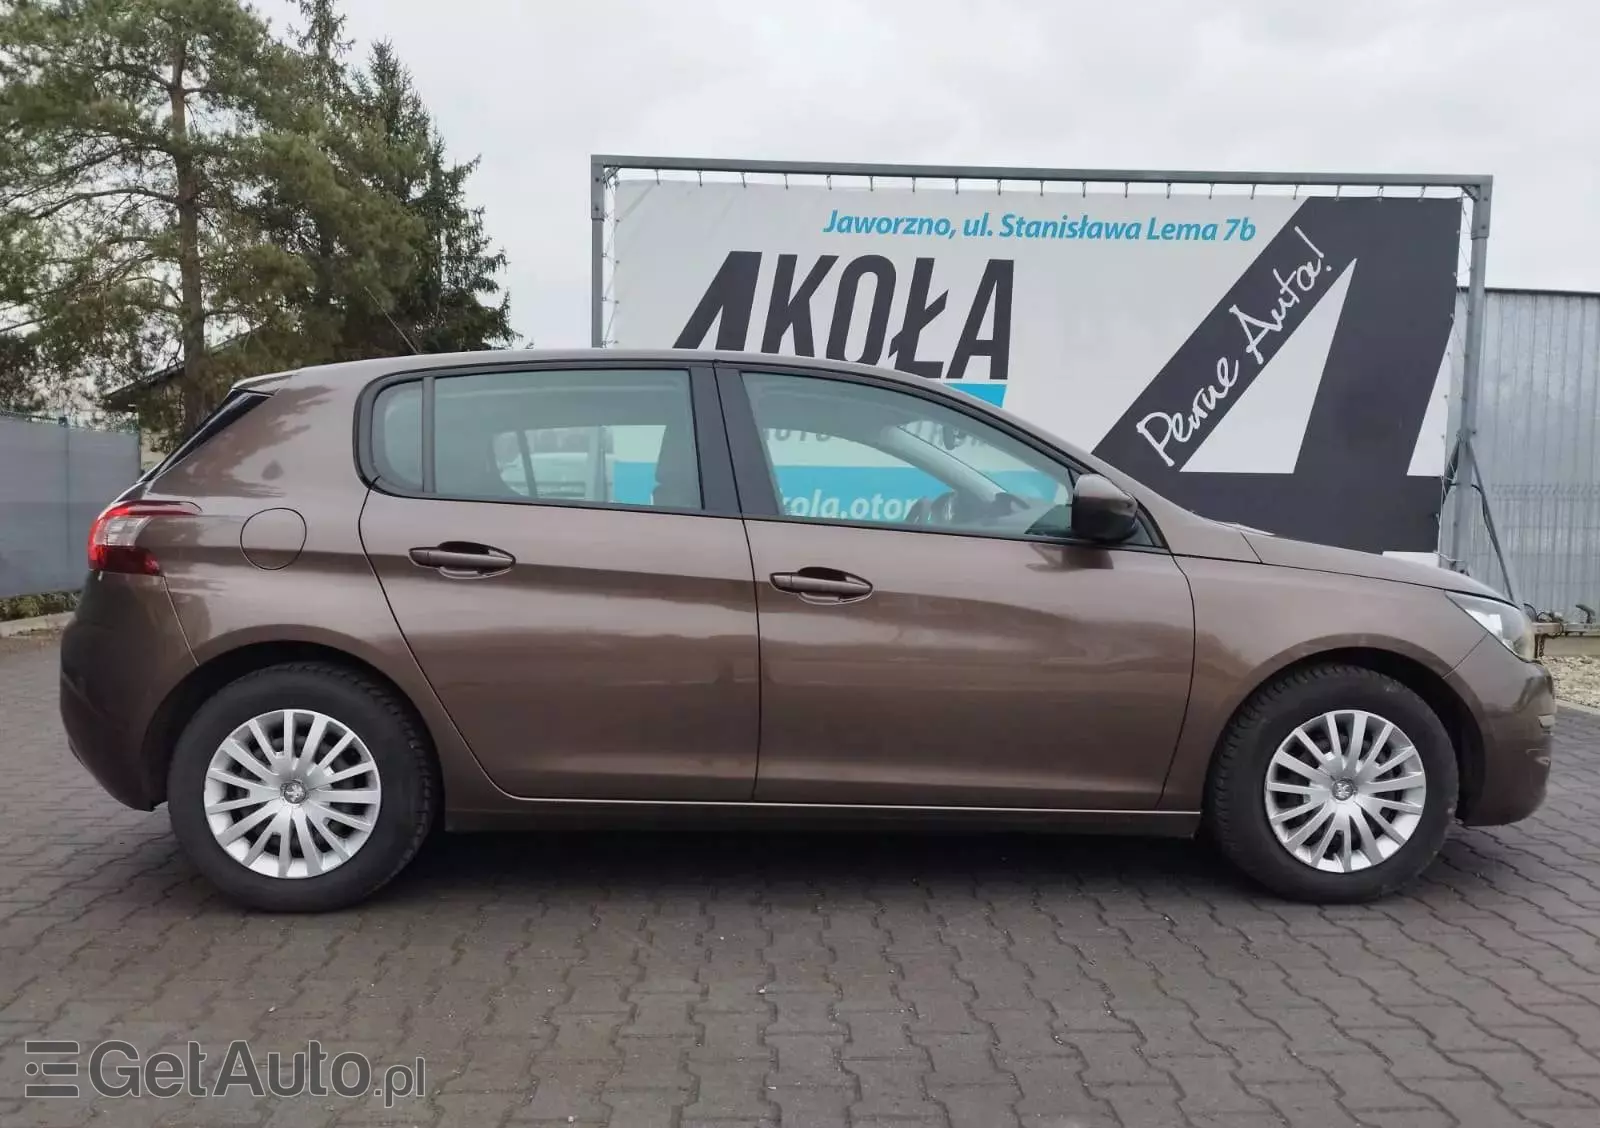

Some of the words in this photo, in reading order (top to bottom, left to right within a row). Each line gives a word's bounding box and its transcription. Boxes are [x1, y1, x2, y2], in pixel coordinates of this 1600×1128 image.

[823, 209, 957, 239] Jaworzno,
[963, 214, 993, 237] ul.
[999, 213, 1141, 241] Stanisława
[1146, 217, 1217, 241] Lema
[1223, 217, 1257, 242] 7b
[672, 250, 1015, 380] AKOŁA
[1228, 225, 1332, 365] Auta!
